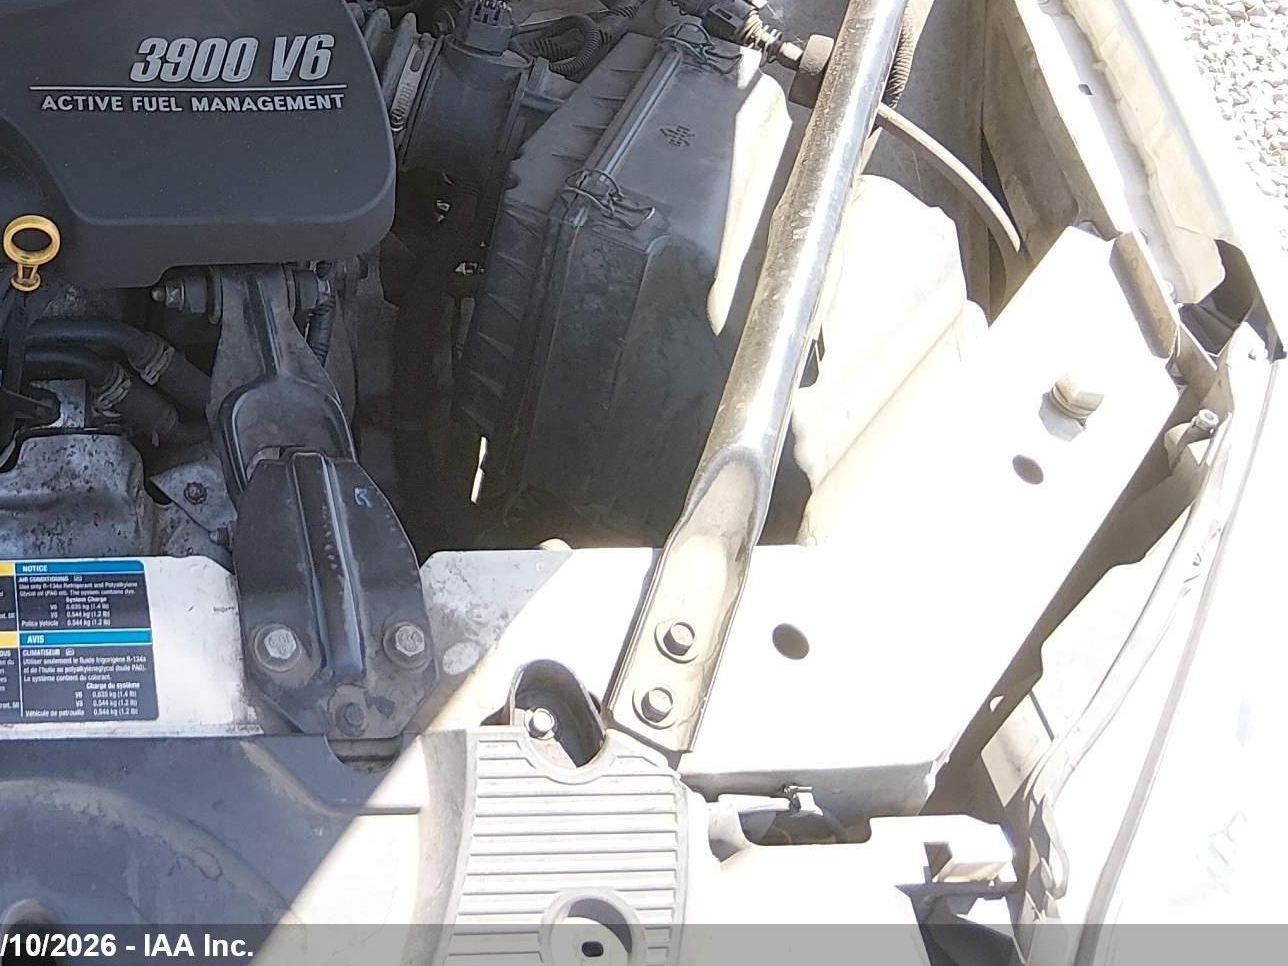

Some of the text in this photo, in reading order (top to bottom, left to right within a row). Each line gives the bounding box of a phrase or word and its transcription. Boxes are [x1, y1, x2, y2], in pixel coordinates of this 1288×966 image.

[129, 34, 335, 82] 3900 V6
[41, 94, 345, 112] ACTIVE FUEL MANAGEMENT
[27, 635, 45, 644] AVIS
[22, 648, 61, 656] CLIMATISEUR
[86, 682, 107, 690] Charge
